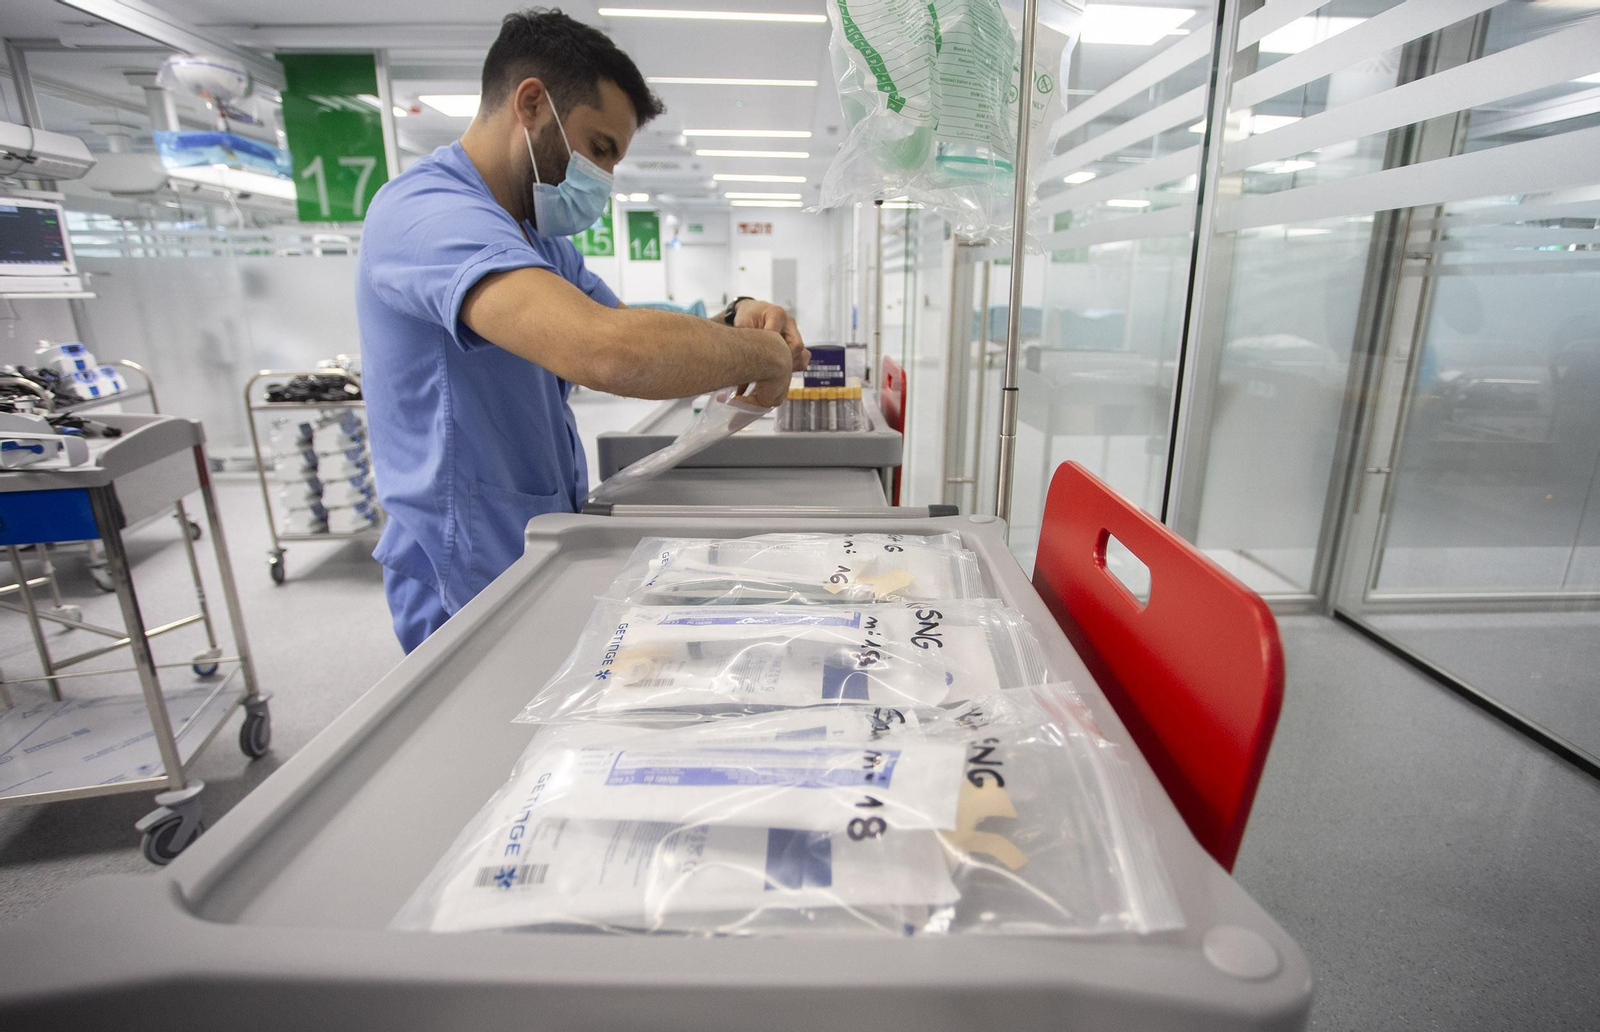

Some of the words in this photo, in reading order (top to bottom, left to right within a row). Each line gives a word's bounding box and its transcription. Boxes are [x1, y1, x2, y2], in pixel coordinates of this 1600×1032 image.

[302, 155, 377, 217] 17
[575, 227, 612, 255] 15
[631, 238, 659, 260] 14
[601, 622, 628, 666] GETINGE
[911, 610, 943, 649] SNG
[504, 772, 552, 856] GETINGE
[847, 795, 887, 841] 18
